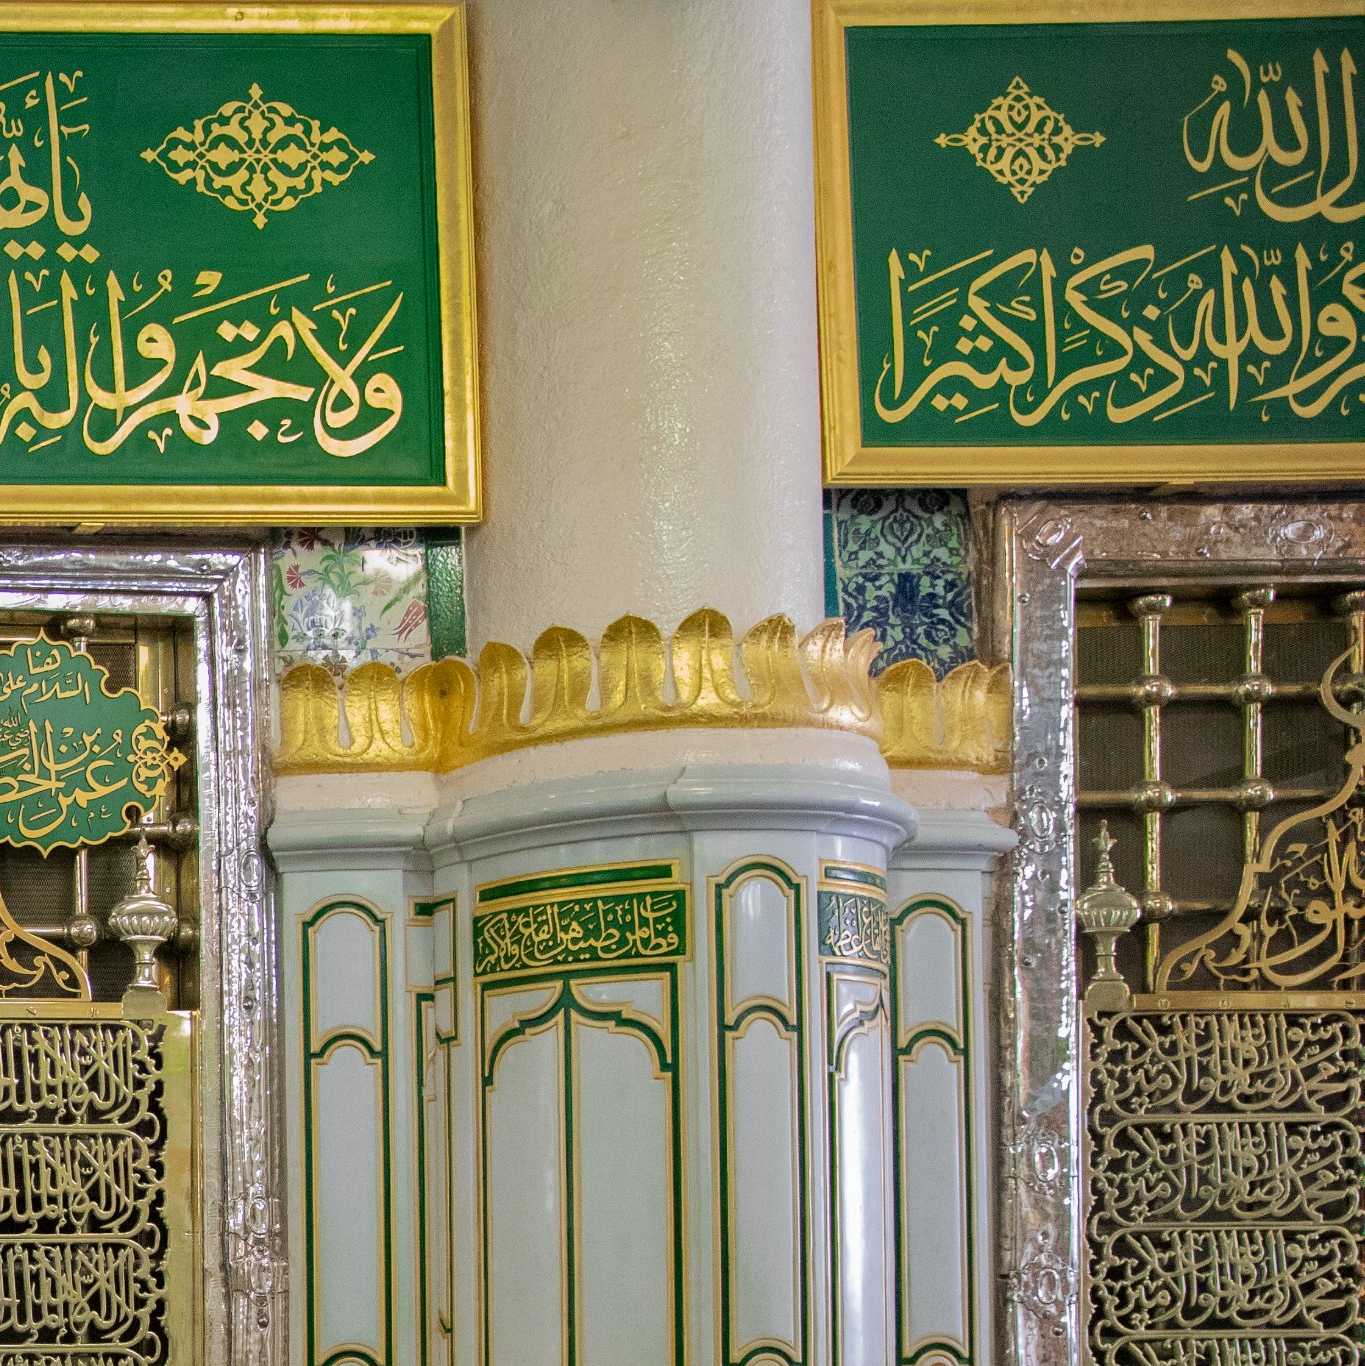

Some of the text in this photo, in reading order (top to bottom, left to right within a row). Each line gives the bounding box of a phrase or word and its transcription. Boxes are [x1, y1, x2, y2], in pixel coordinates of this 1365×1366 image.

[1180, 47, 1330, 206] الله
[83, 269, 315, 458] تجهروا
[20, 671, 90, 715] السلام
[26, 647, 61, 675] هنا
[18, 758, 129, 839] عمر
